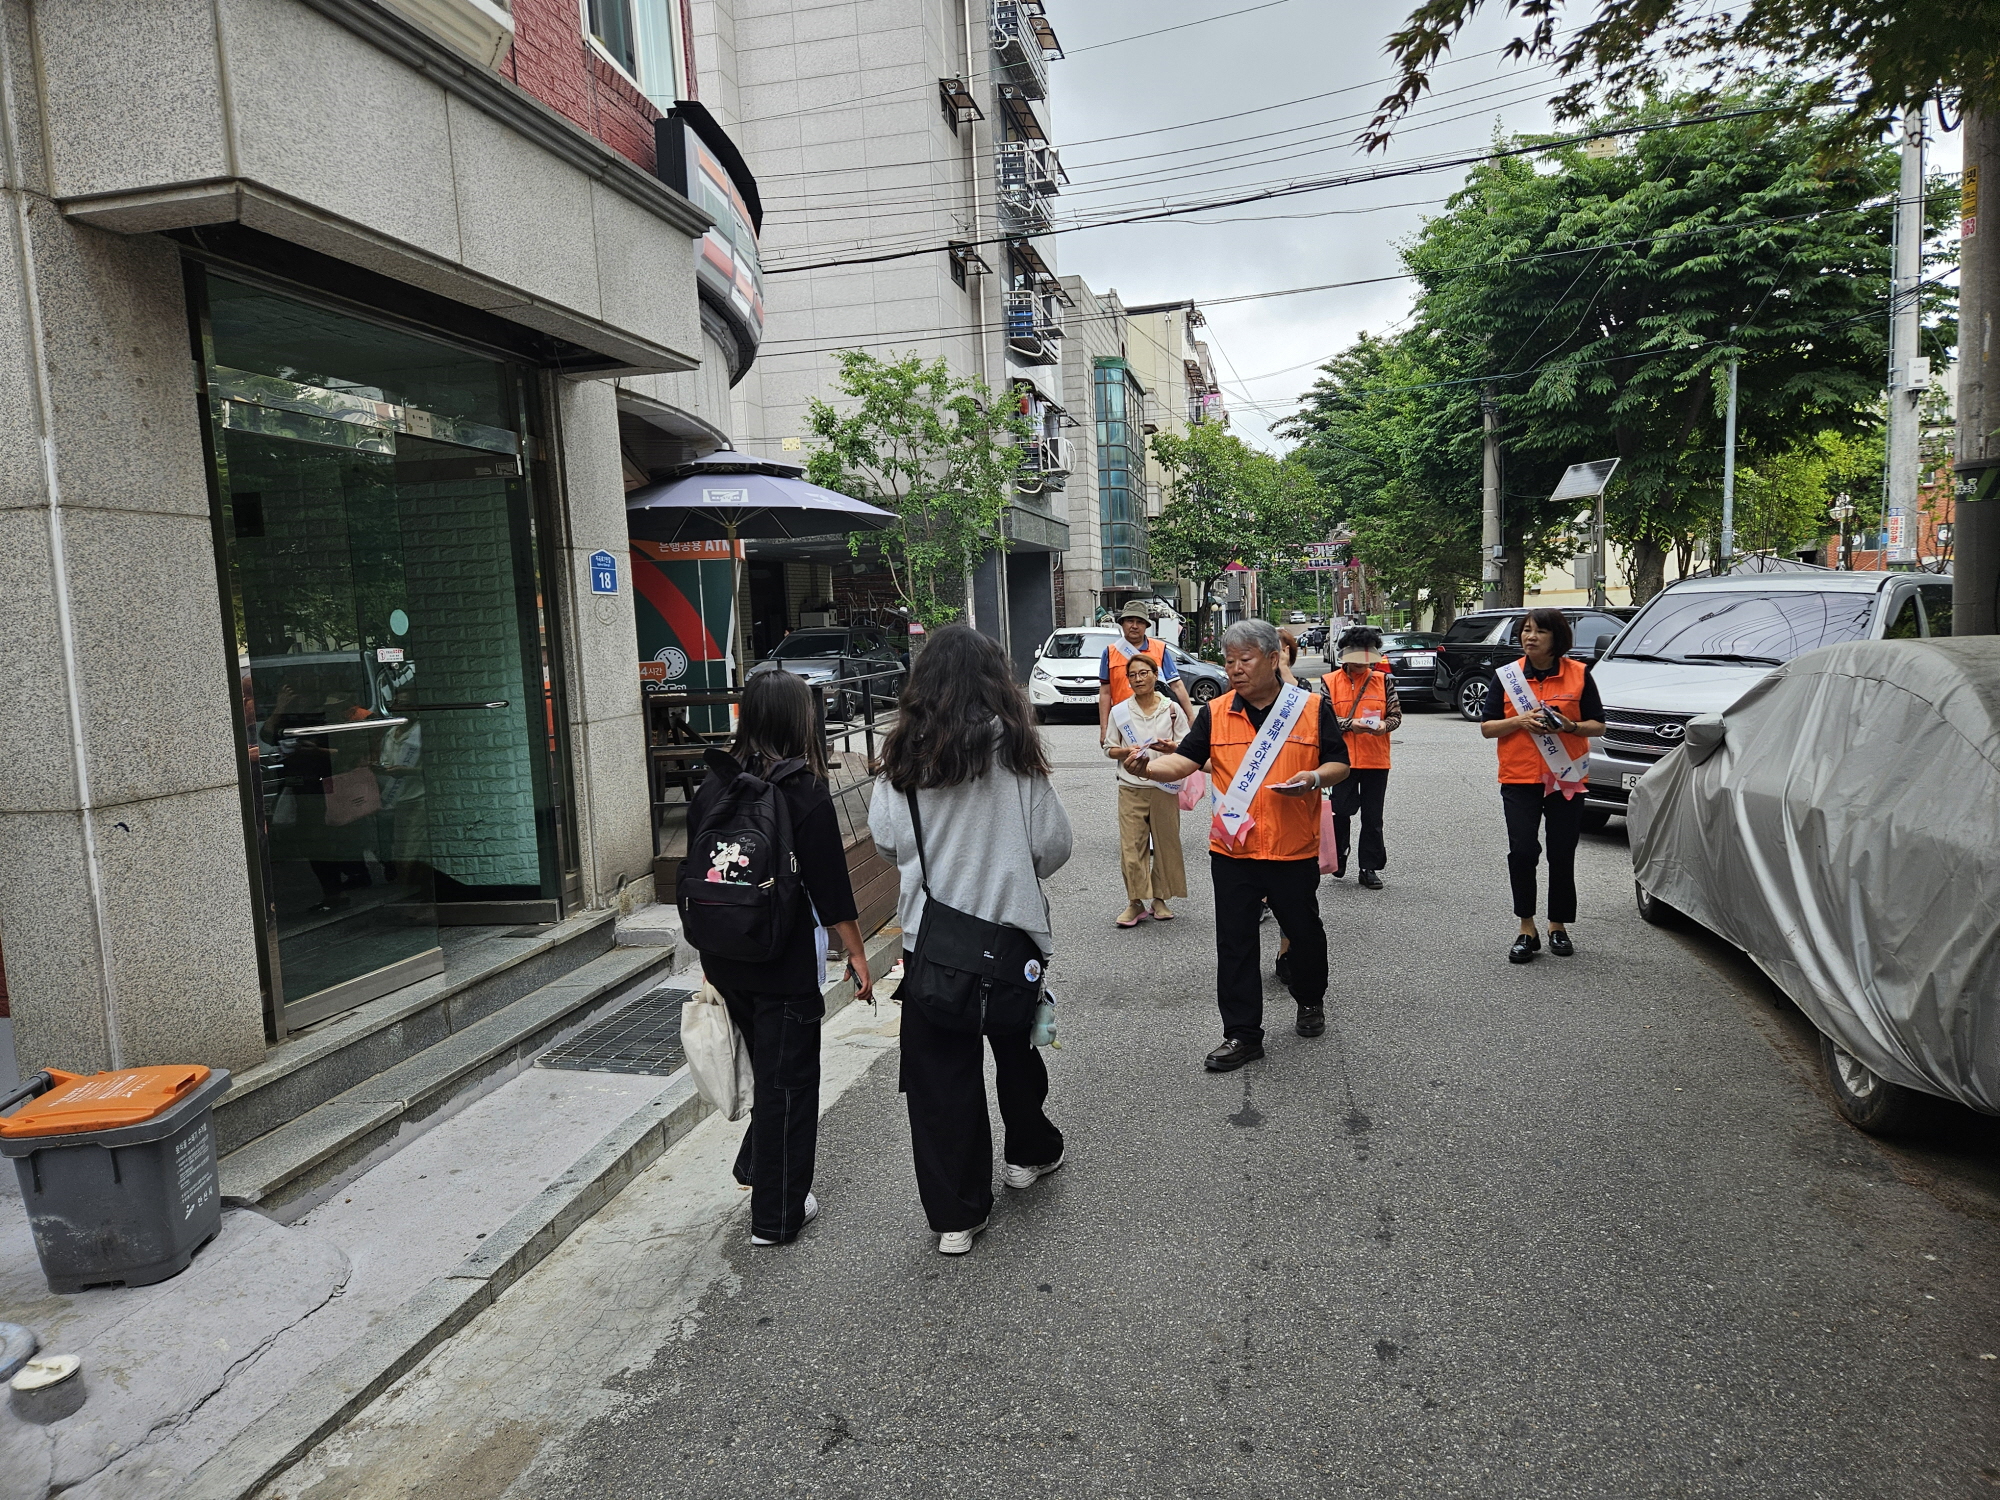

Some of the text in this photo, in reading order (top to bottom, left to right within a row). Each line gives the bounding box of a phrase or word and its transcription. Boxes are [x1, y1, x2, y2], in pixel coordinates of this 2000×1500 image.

[659, 541, 702, 552] 은행공용
[599, 572, 611, 589] 18
[640, 666, 662, 677] 4시간
[1278, 693, 1299, 720] 이웃을
[1266, 718, 1285, 742] 함께
[1237, 740, 1272, 793] 찾아주세요
[197, 1185, 213, 1207] 안산시
